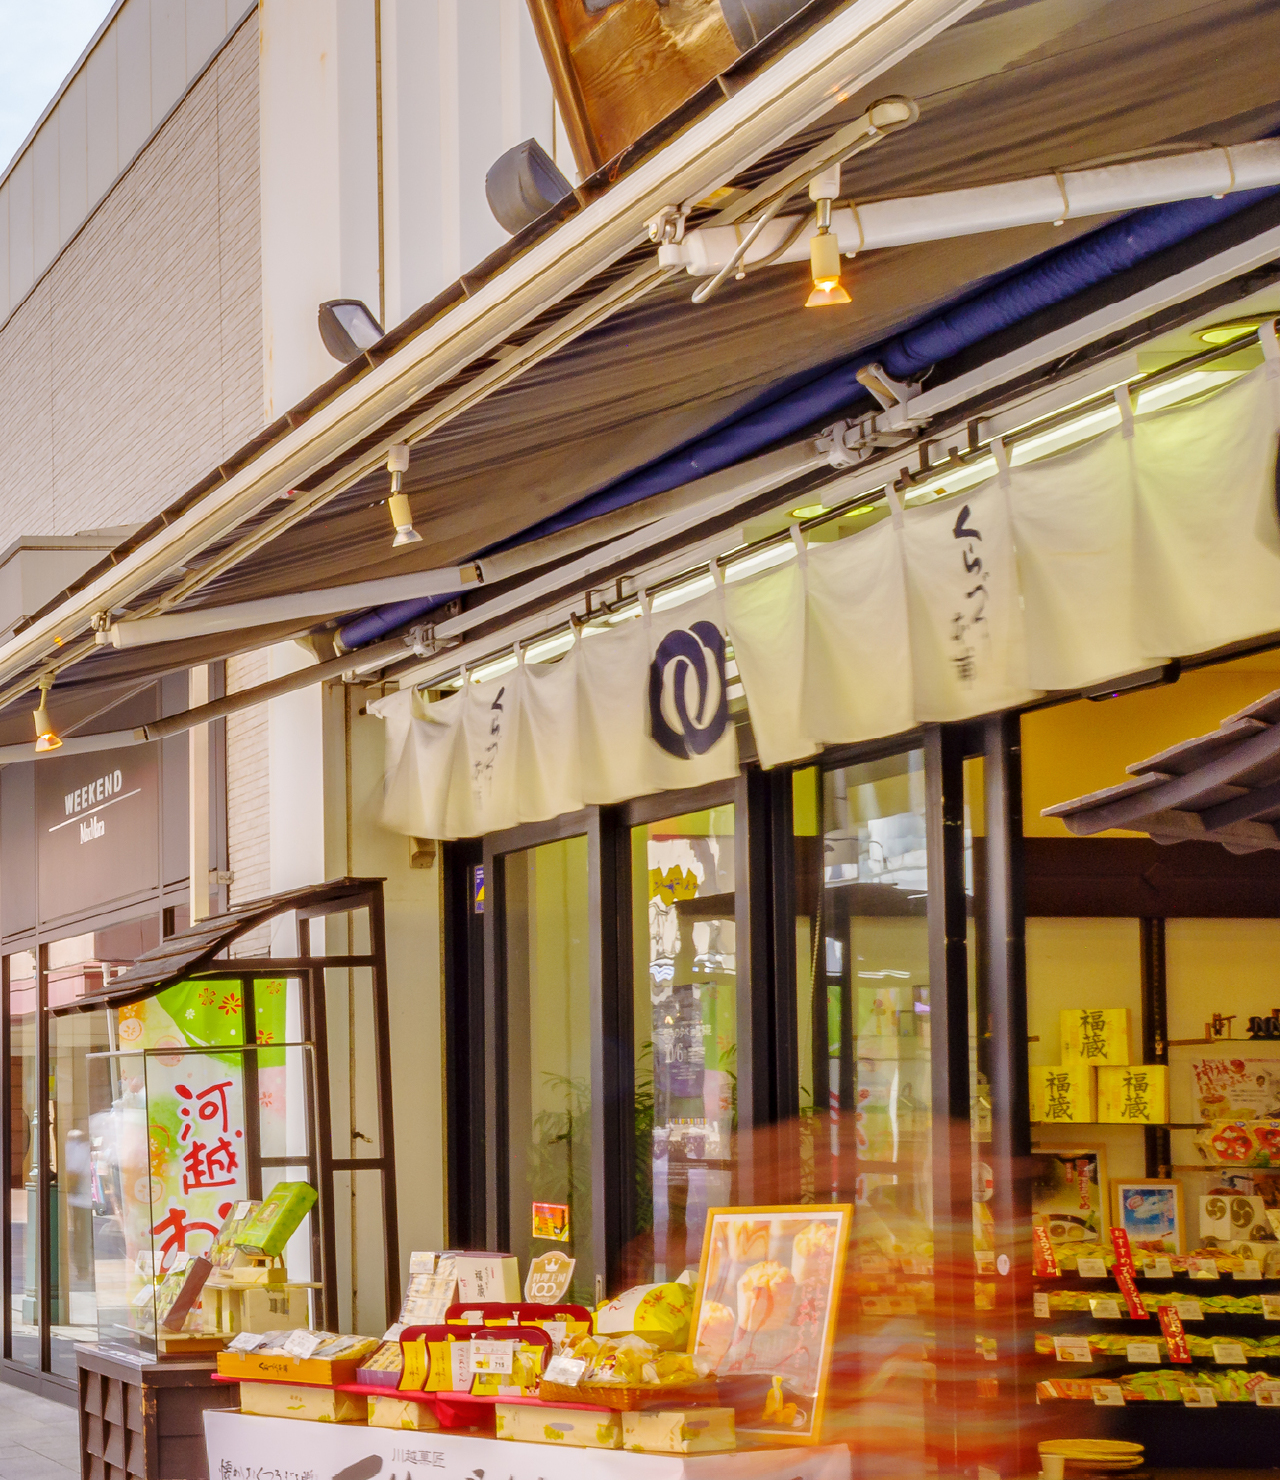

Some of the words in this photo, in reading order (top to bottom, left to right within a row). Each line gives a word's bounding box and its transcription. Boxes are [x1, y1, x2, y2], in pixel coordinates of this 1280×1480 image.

[64, 769, 122, 816] WEEKEND
[1080, 1010, 1107, 1059] 福蔵
[1045, 1071, 1073, 1120] 福蔵
[1121, 1071, 1150, 1121] 福蔵
